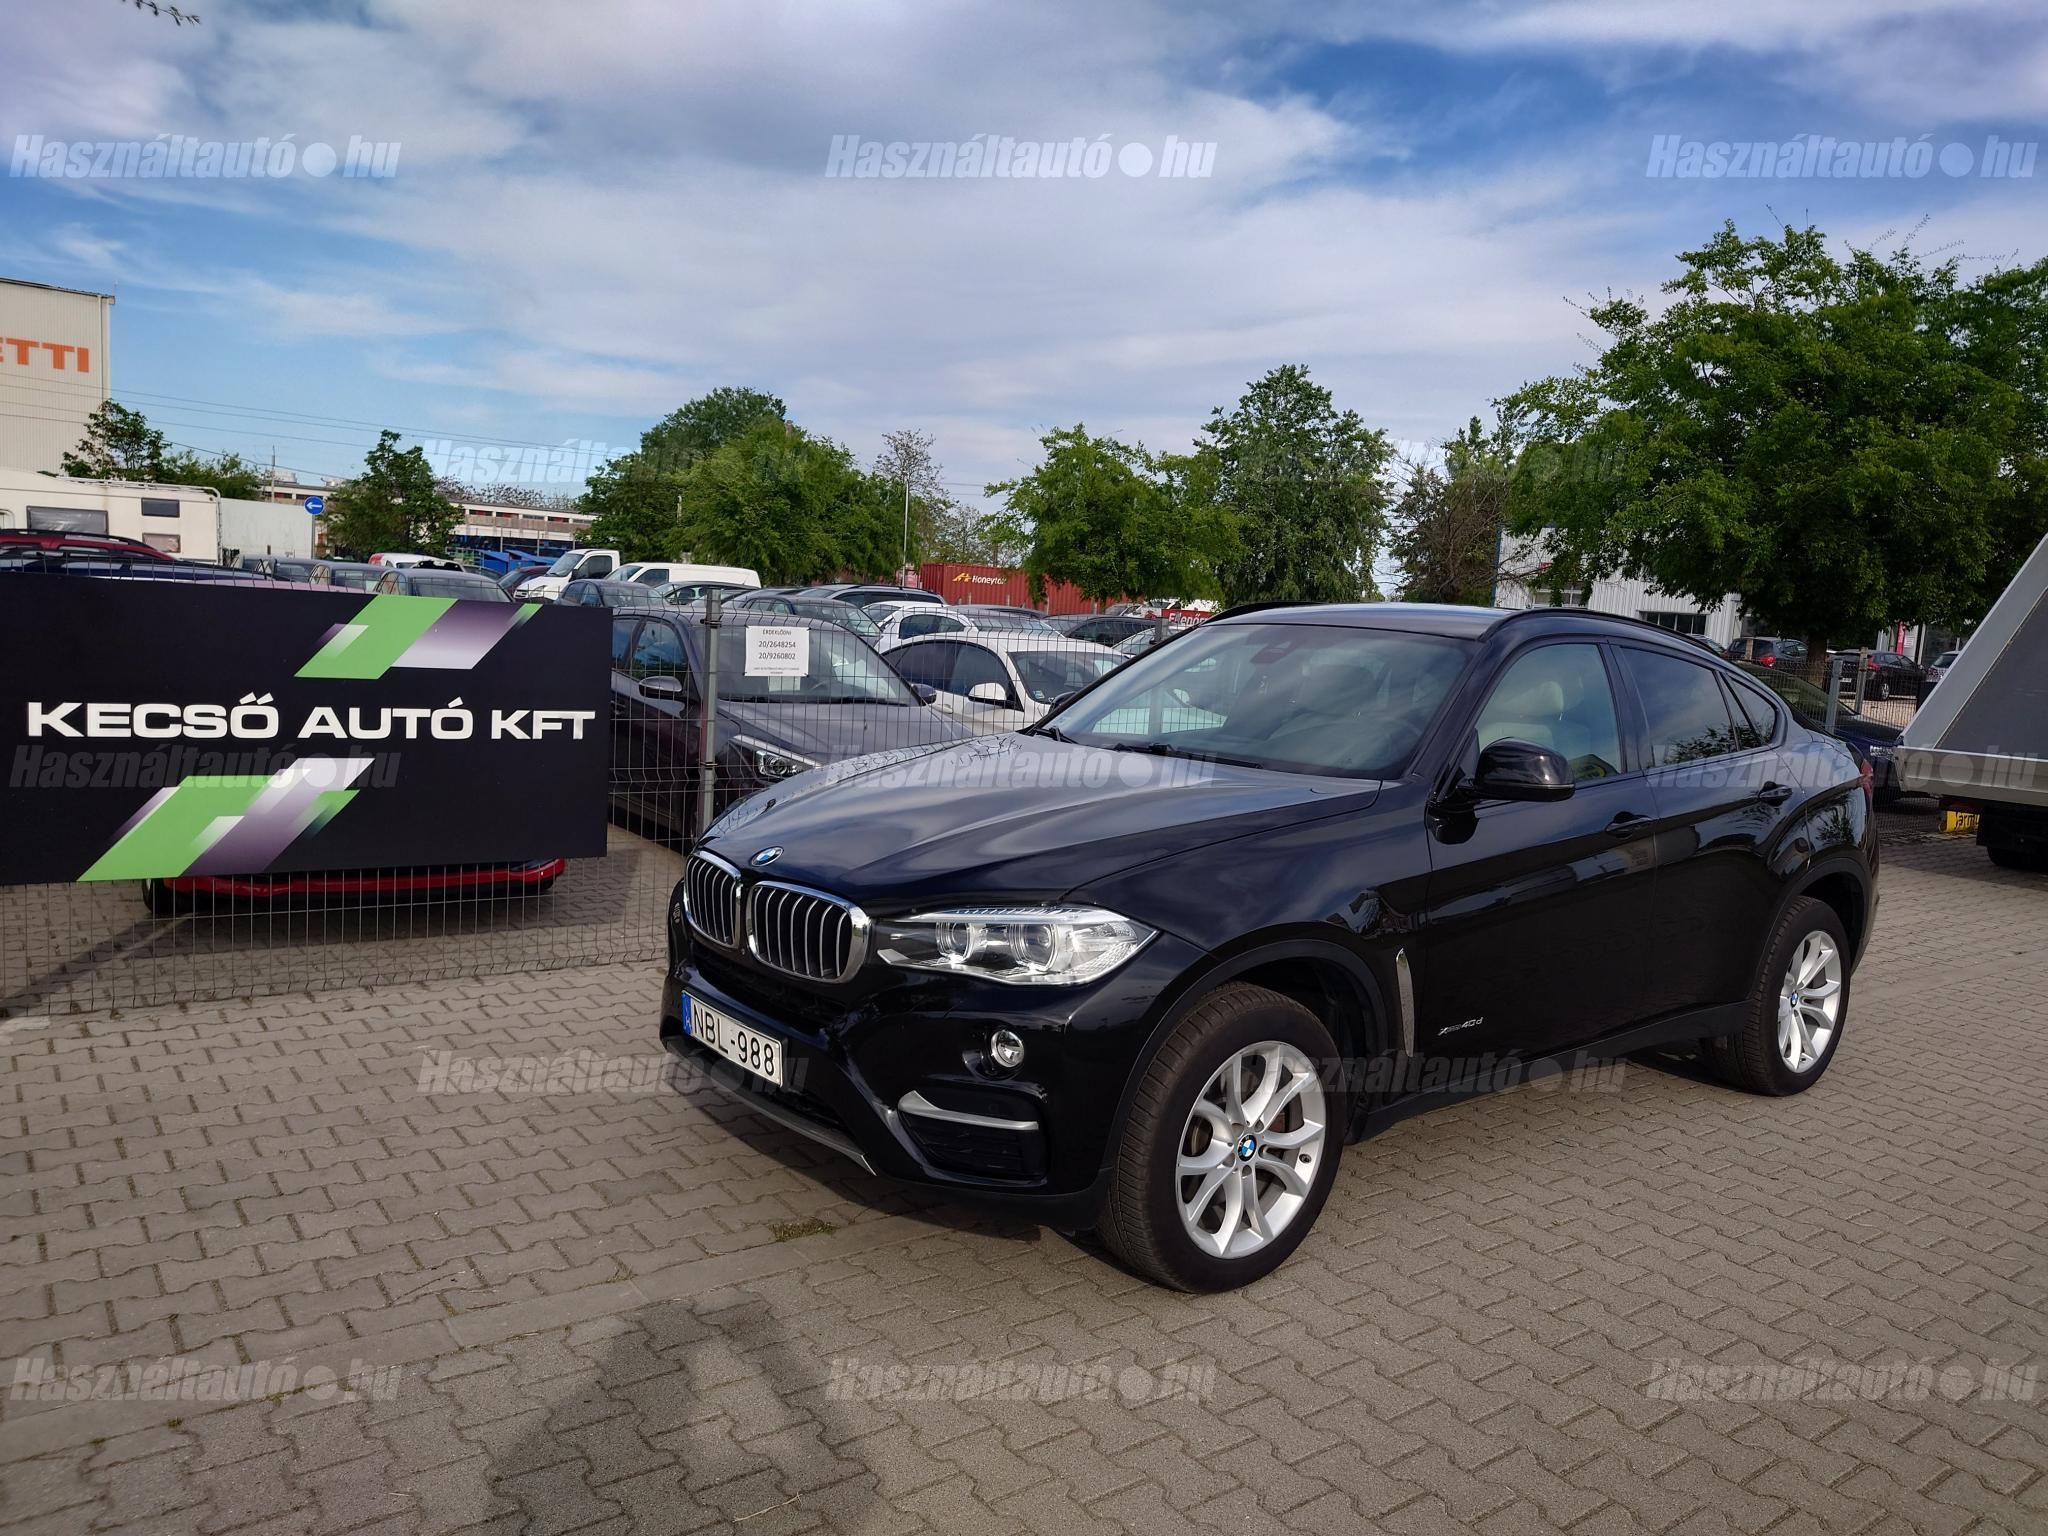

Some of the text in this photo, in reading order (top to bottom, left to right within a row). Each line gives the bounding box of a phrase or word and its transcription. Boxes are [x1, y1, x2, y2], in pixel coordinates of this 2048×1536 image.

[27, 692, 596, 740] KECSŐ AUTÓ KFT
[693, 1003, 775, 1077] NBL-988
